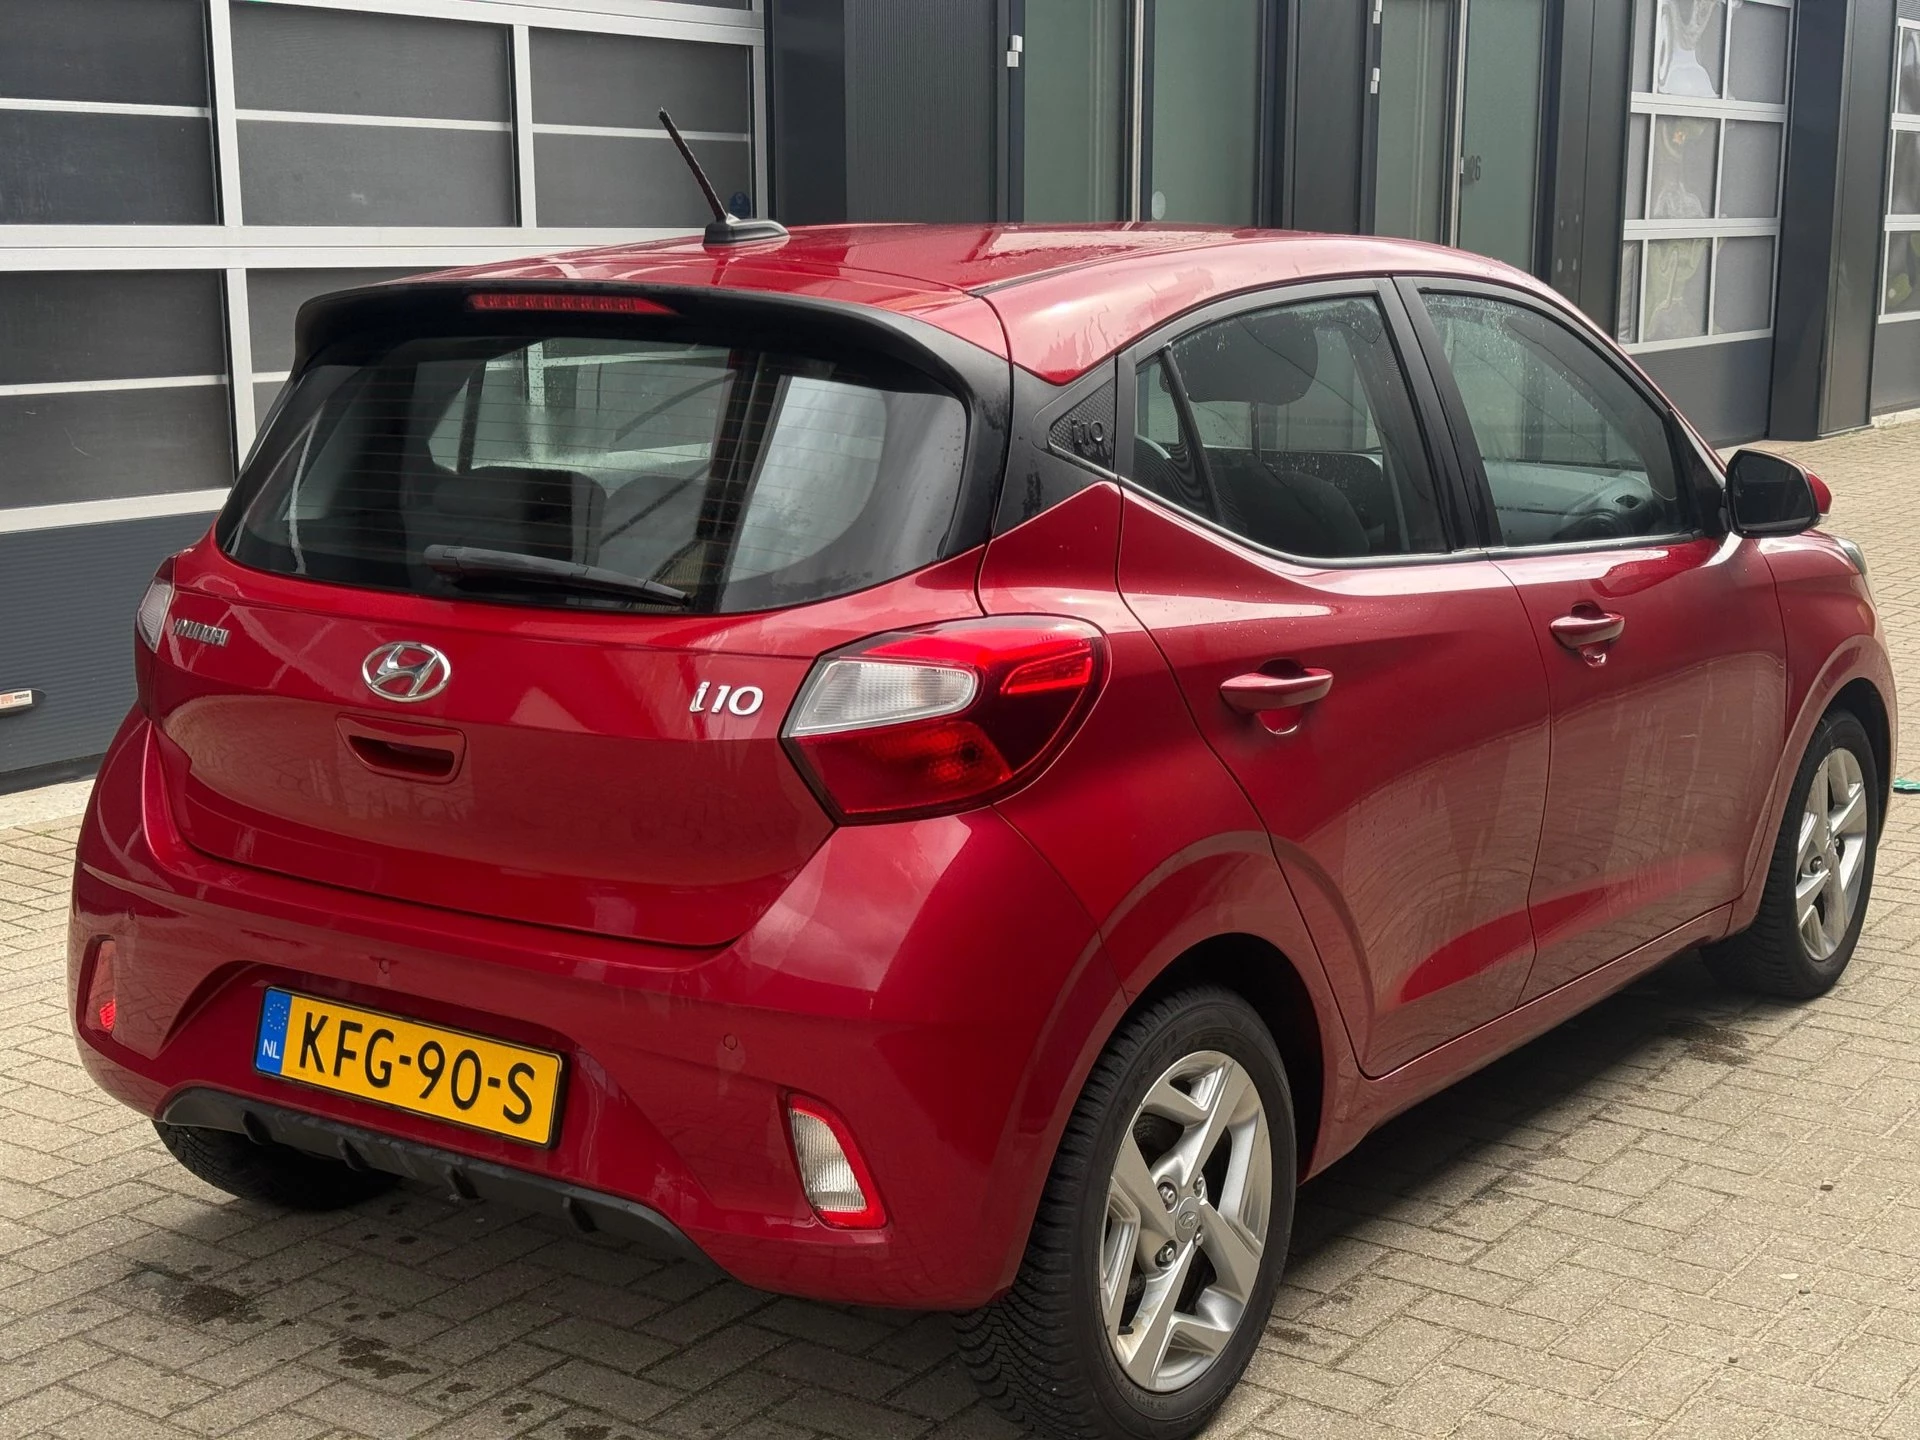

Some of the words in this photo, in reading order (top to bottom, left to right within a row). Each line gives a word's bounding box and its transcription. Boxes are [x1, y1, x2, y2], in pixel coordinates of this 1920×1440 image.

[689, 681, 764, 716] i10
[262, 1037, 280, 1060] NL
[299, 1011, 536, 1125] KFG-90-S
